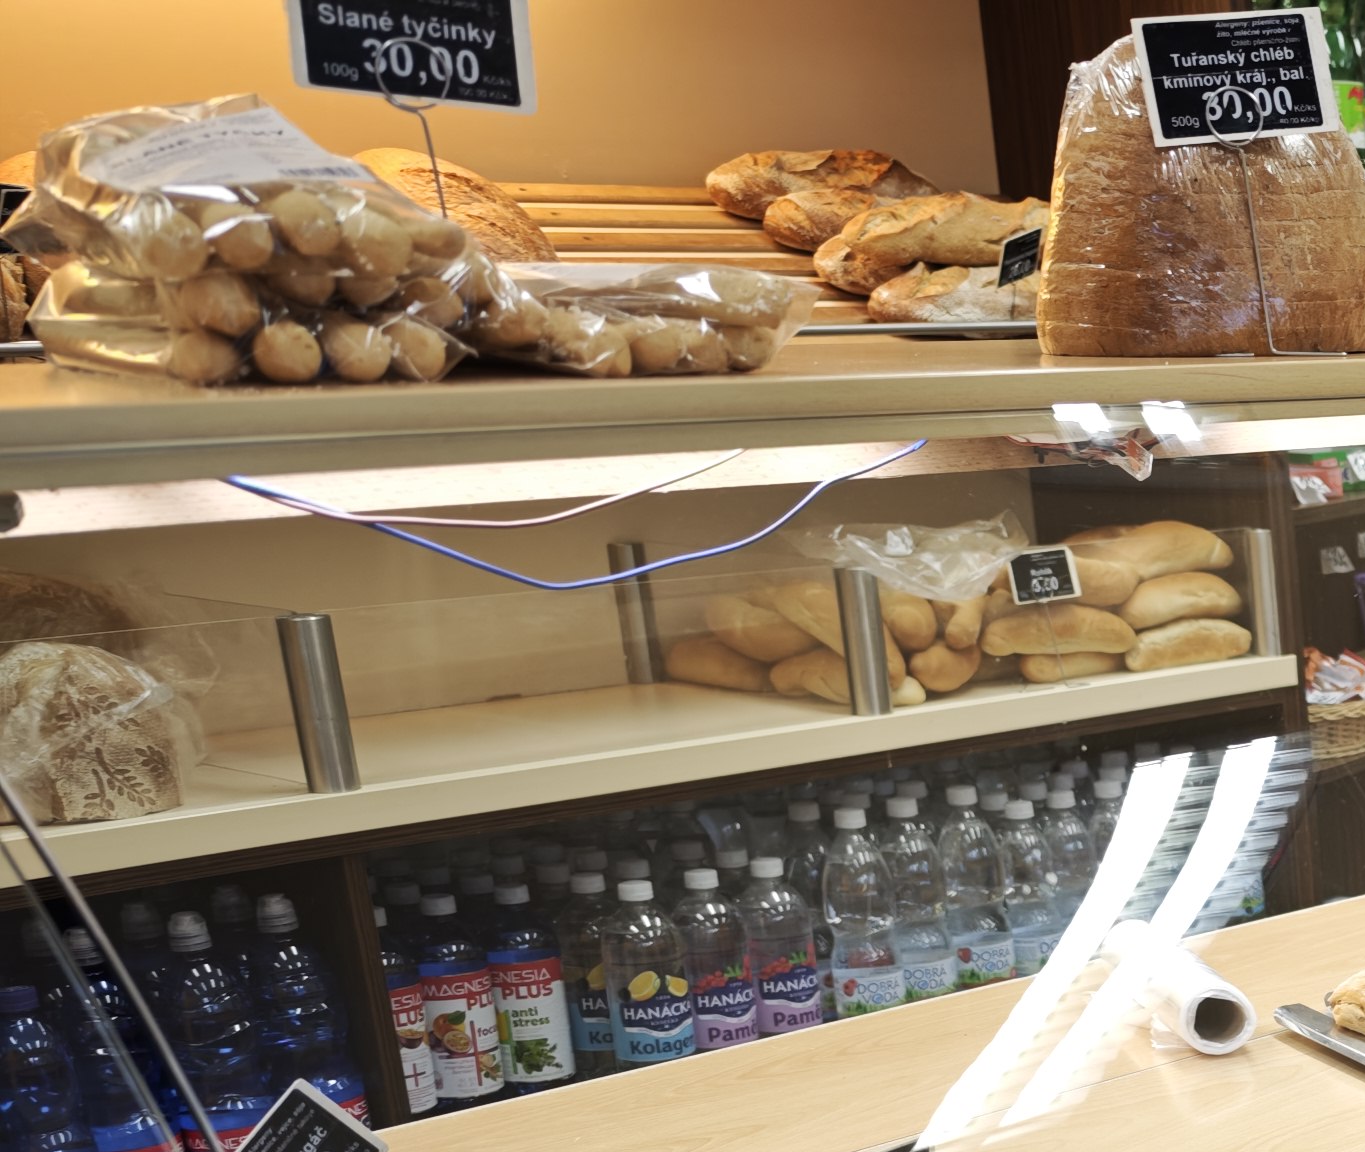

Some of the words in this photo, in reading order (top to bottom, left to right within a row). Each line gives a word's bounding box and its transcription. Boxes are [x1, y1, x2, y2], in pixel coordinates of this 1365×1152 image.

[317, 3, 394, 32] Slané
[402, 15, 496, 49] tyčinky
[362, 38, 479, 85] 30,00
[1170, 49, 1246, 68] Tuřanský
[1250, 47, 1295, 63] chléb
[323, 62, 359, 81] 100g
[1236, 69, 1277, 86] kráj.,
[1279, 66, 1310, 82] bal.
[1171, 115, 1200, 128] 500g
[971, 946, 1011, 963] DOBRÁ
[904, 963, 947, 981] DOBRÁ
[976, 957, 1010, 973] VODA
[501, 984, 553, 1000] PLUS
[857, 978, 900, 995] DOBRÁ
[911, 978, 946, 991] VODA
[862, 993, 899, 1005] VODA
[511, 1006, 539, 1018] anti
[512, 1017, 550, 1028] stress
